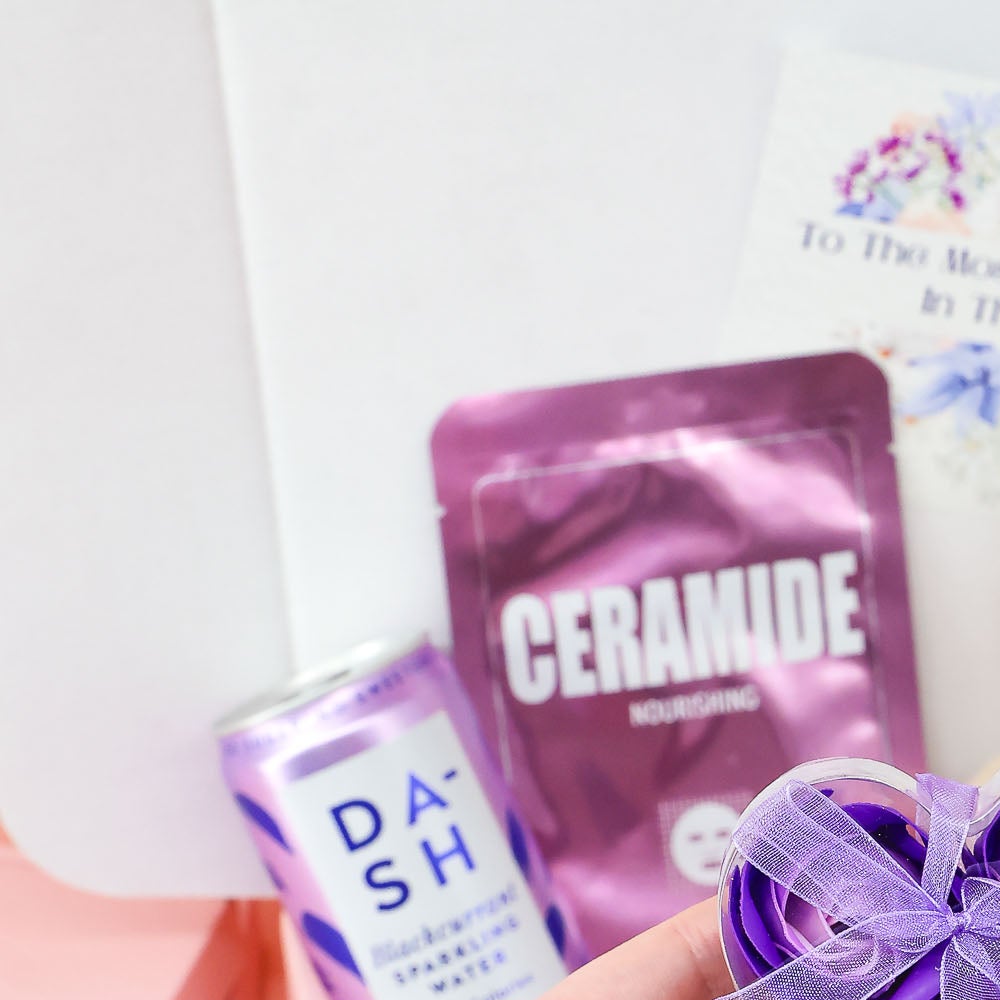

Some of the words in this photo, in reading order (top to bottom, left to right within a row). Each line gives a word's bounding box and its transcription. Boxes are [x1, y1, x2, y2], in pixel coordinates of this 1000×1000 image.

[799, 219, 846, 255] To
[860, 226, 930, 268] The
[918, 285, 958, 318] In
[501, 551, 866, 704] CERAMIDE
[628, 684, 762, 728] NOURISHING
[364, 824, 475, 912] SH
[393, 914, 519, 986] SPARKLING
[429, 950, 507, 993] WATER
